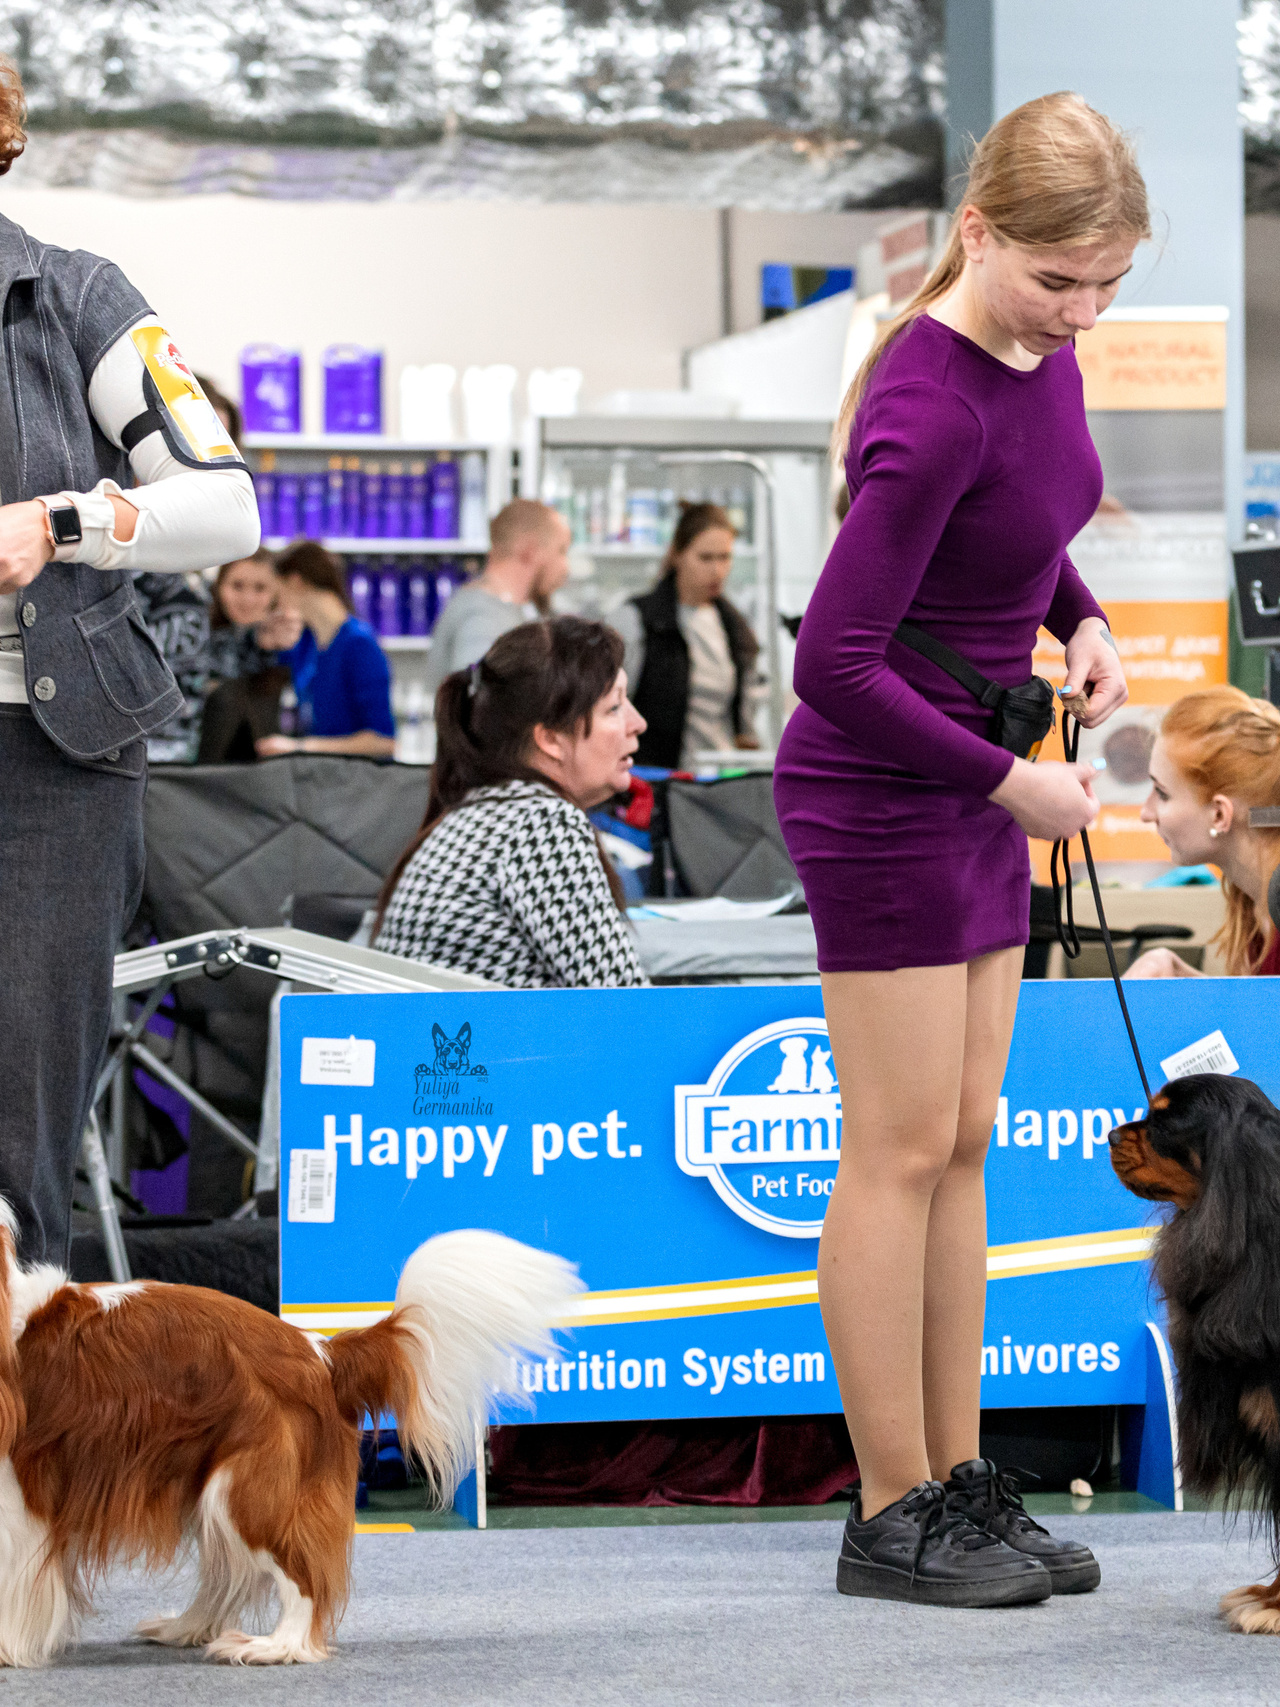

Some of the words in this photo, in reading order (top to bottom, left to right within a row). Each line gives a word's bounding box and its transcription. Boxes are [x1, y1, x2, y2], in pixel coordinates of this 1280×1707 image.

[1109, 365, 1220, 387] PRODUCT
[324, 1114, 509, 1180] Happy
[532, 1109, 643, 1176] pet.
[752, 1174, 789, 1199] Pet
[500, 1350, 667, 1394] utrition
[683, 1347, 826, 1395] System
